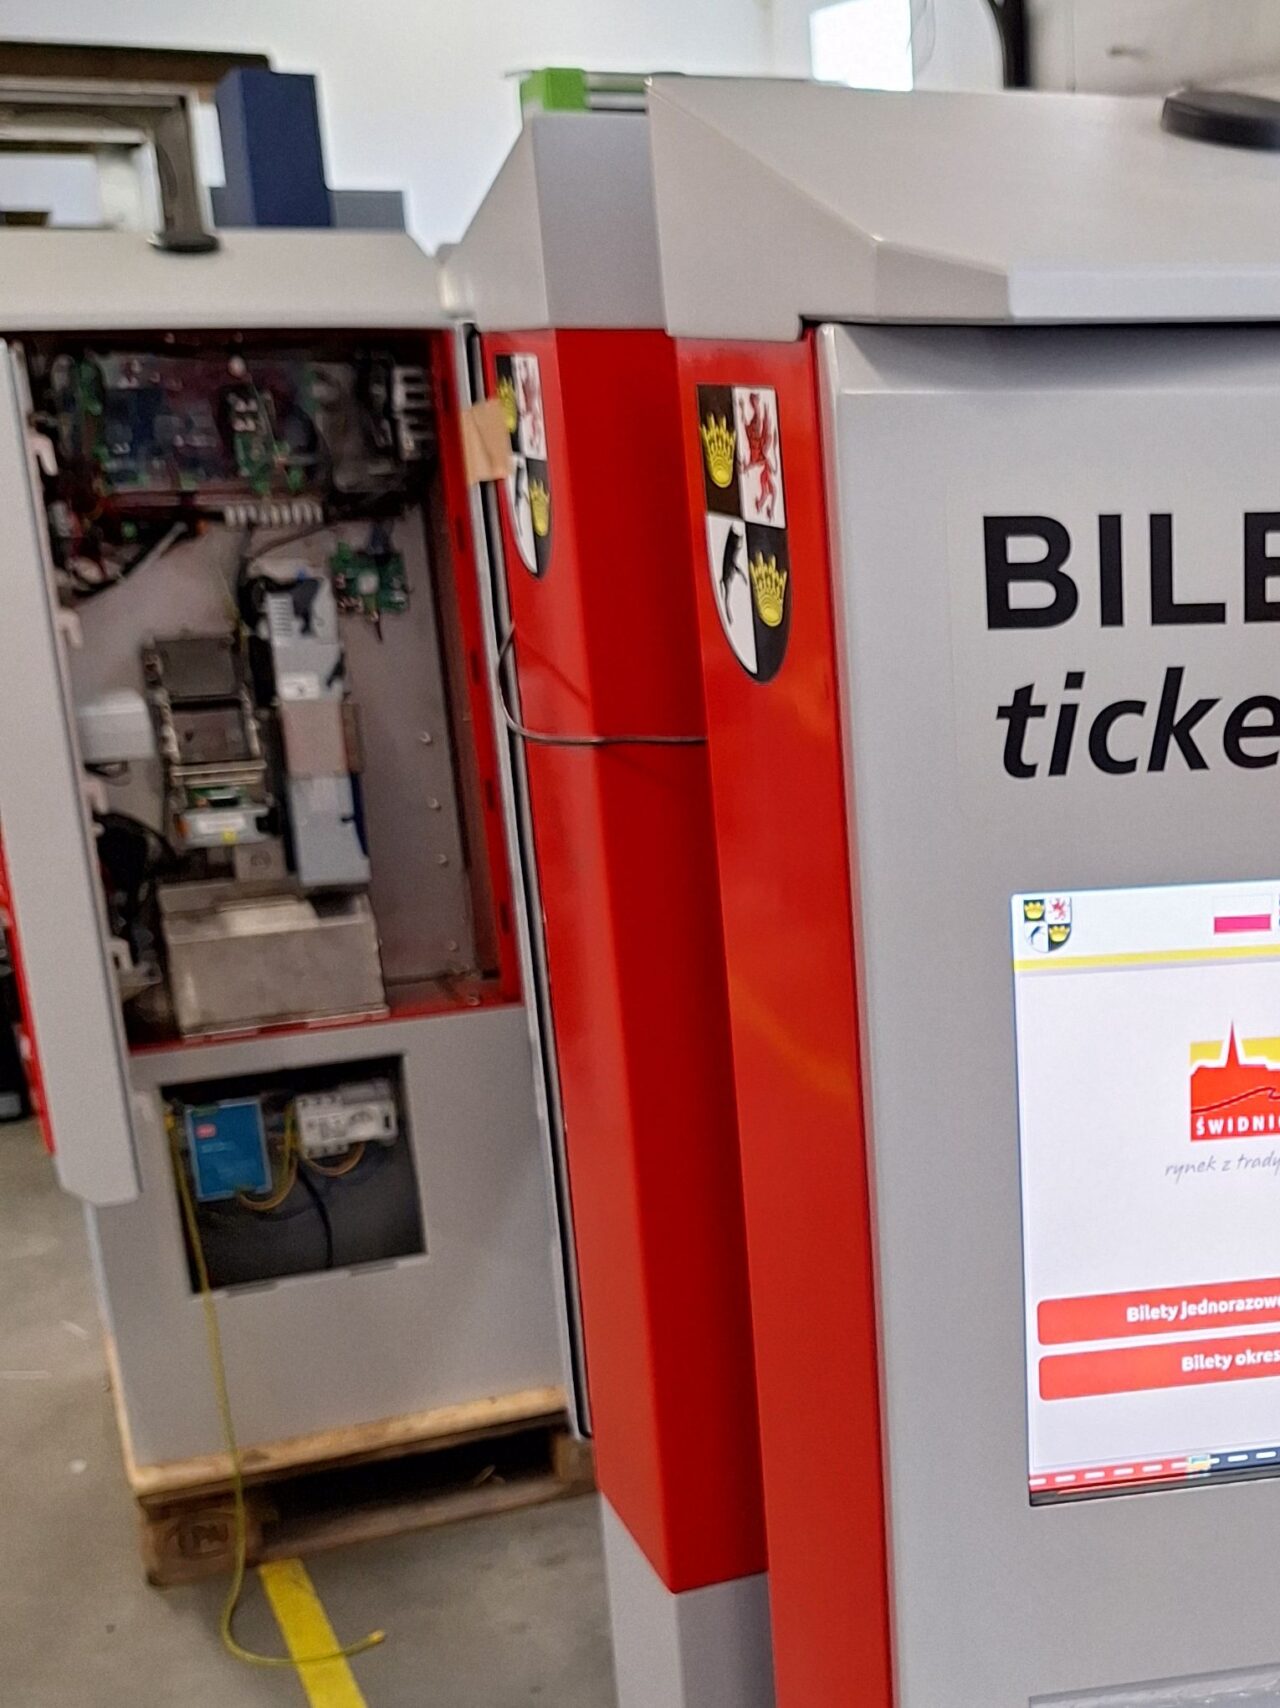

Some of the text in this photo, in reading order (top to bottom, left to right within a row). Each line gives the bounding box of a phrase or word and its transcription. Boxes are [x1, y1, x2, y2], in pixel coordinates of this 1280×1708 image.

[1165, 1155, 1216, 1184] rynek
[1221, 1160, 1232, 1172] z
[1126, 1305, 1178, 1322] Bilety
[1182, 1354, 1232, 1371] Bilety
